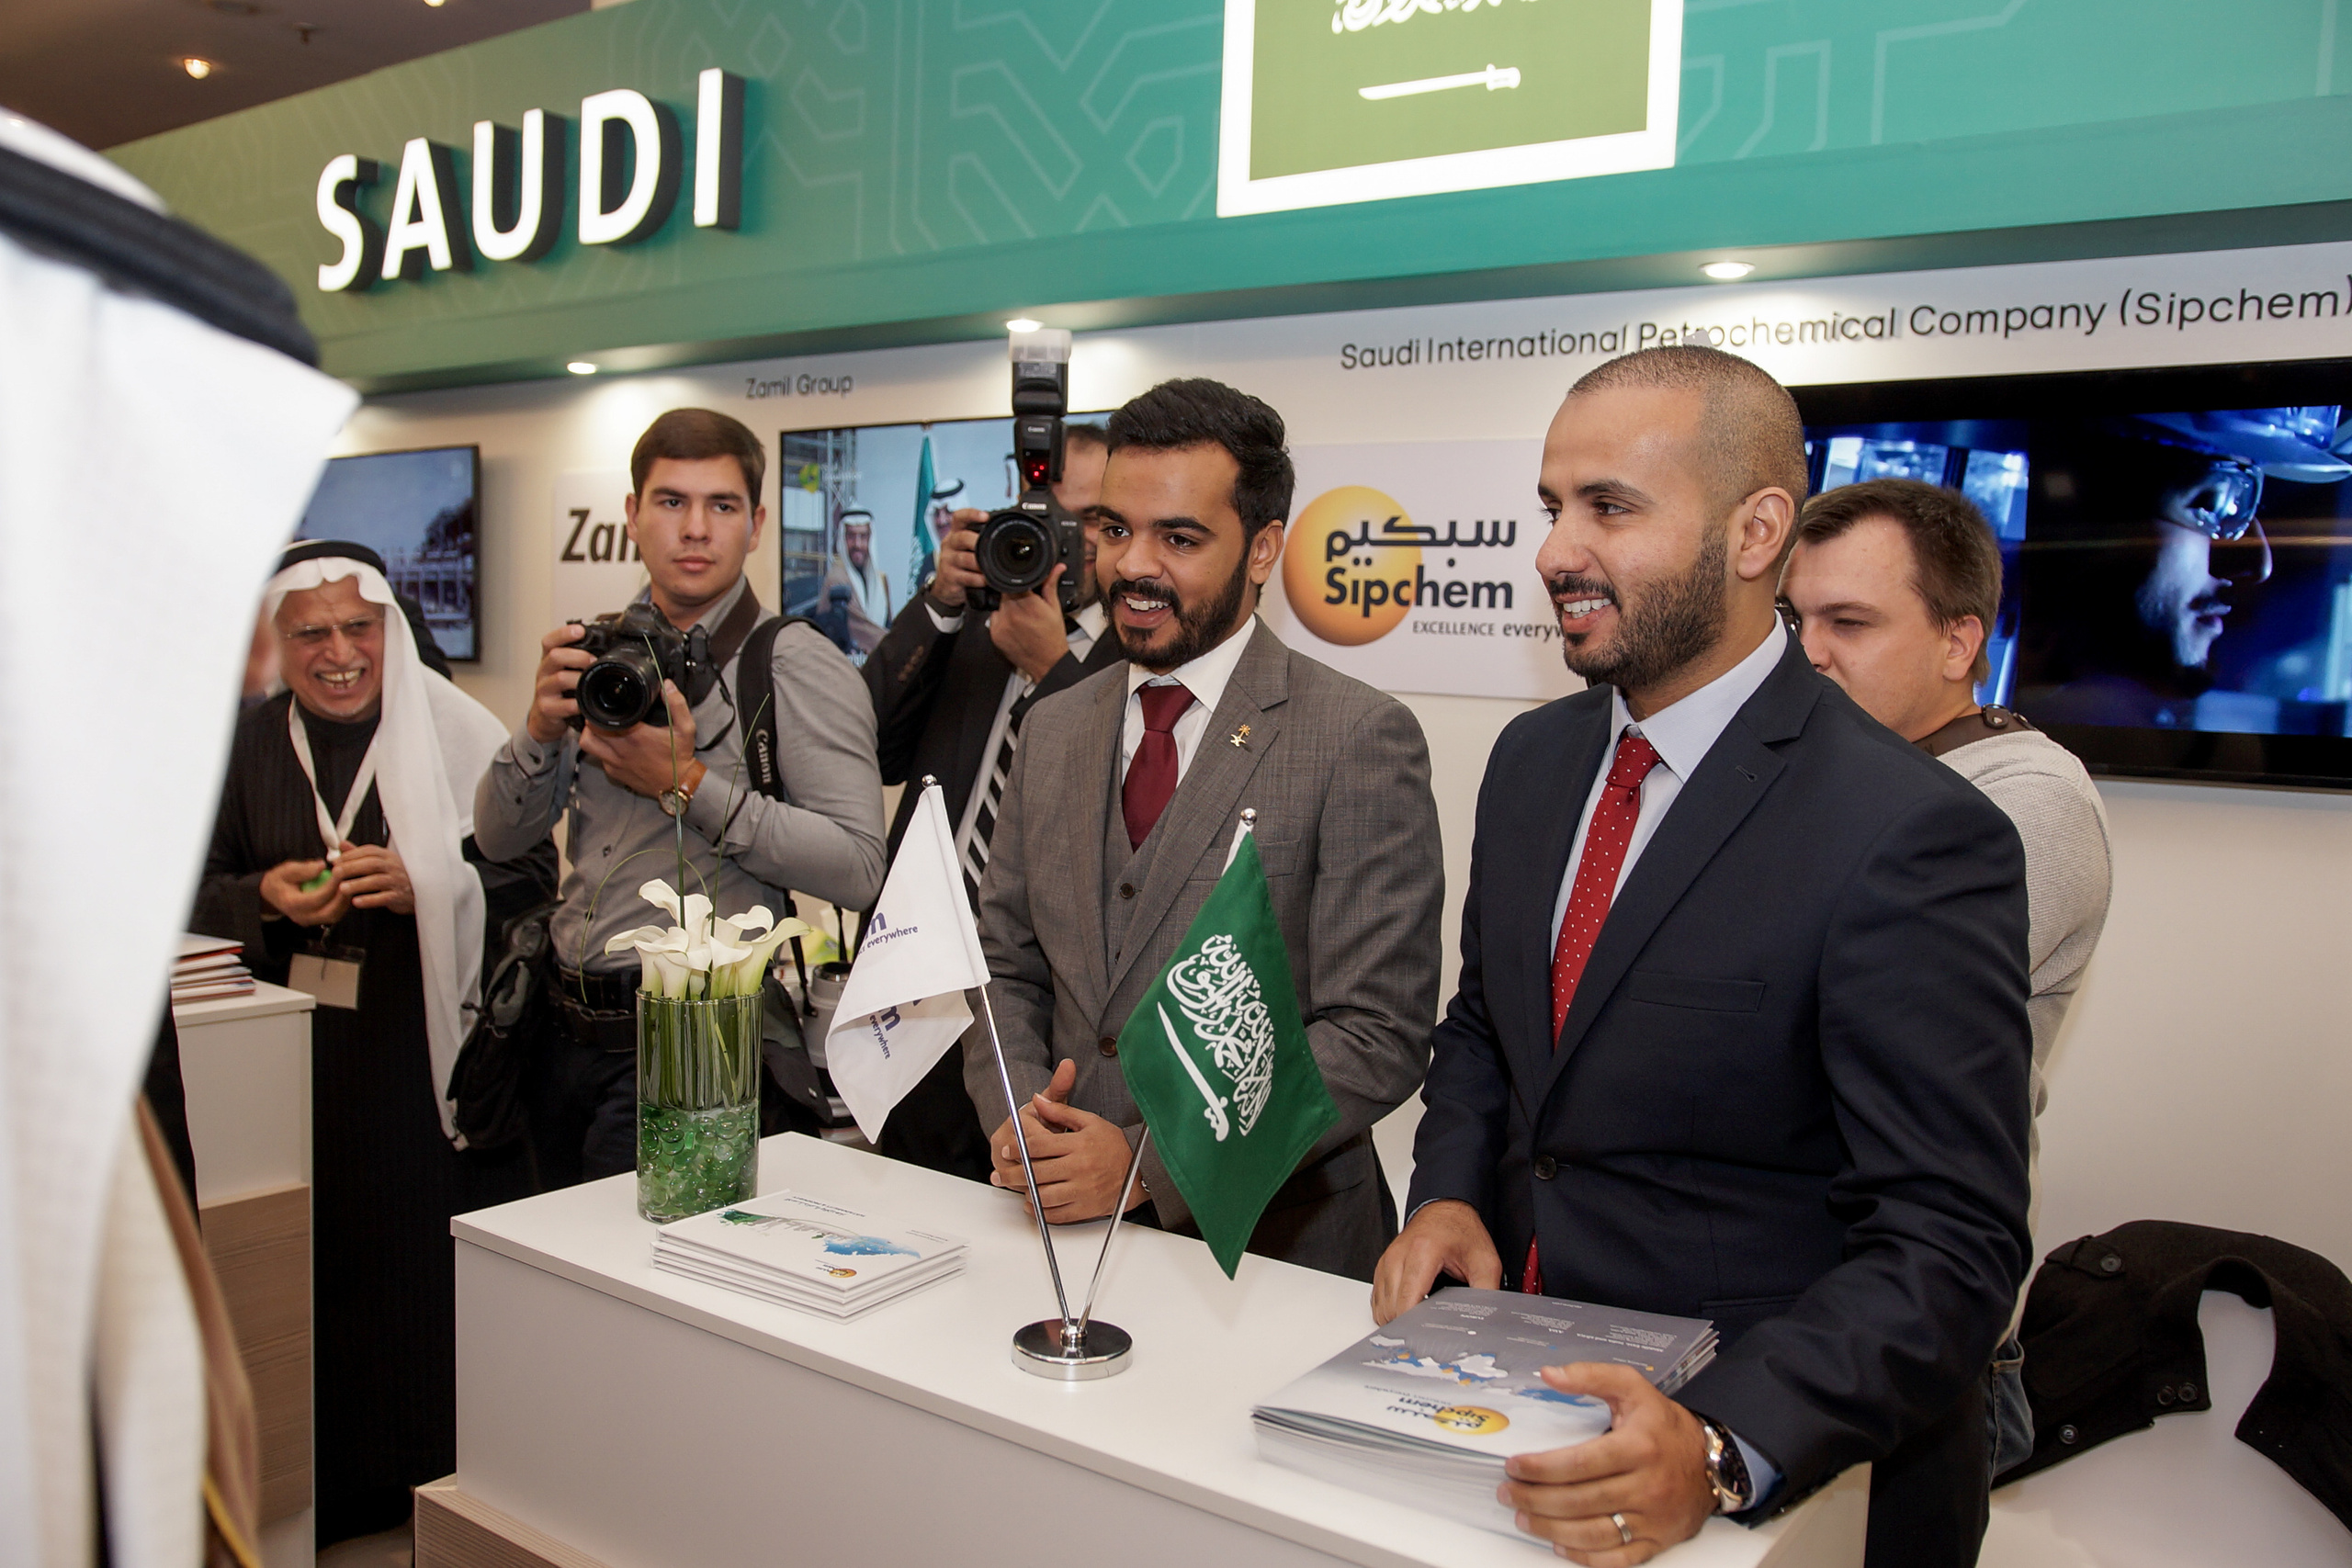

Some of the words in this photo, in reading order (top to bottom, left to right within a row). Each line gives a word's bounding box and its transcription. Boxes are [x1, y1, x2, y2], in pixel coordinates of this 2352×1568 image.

[316, 67, 726, 292] SAUDI
[1341, 338, 1420, 368] Saudi
[1427, 321, 1627, 363] International
[1639, 307, 1896, 348] Petochemical
[1910, 302, 2108, 339] Company
[2120, 274, 2352, 332] (Sipchem)
[745, 377, 791, 400] Zamil
[797, 373, 854, 398] Group
[1325, 516, 1516, 568] سبكيم
[1324, 565, 1513, 618] Sipchem
[1413, 621, 1495, 636] EXCELLENCE
[755, 728, 773, 784] Canon
[866, 925, 919, 949] everywhere
[869, 1014, 891, 1059] everywhere
[1398, 1396, 1490, 1423] Sipchem
